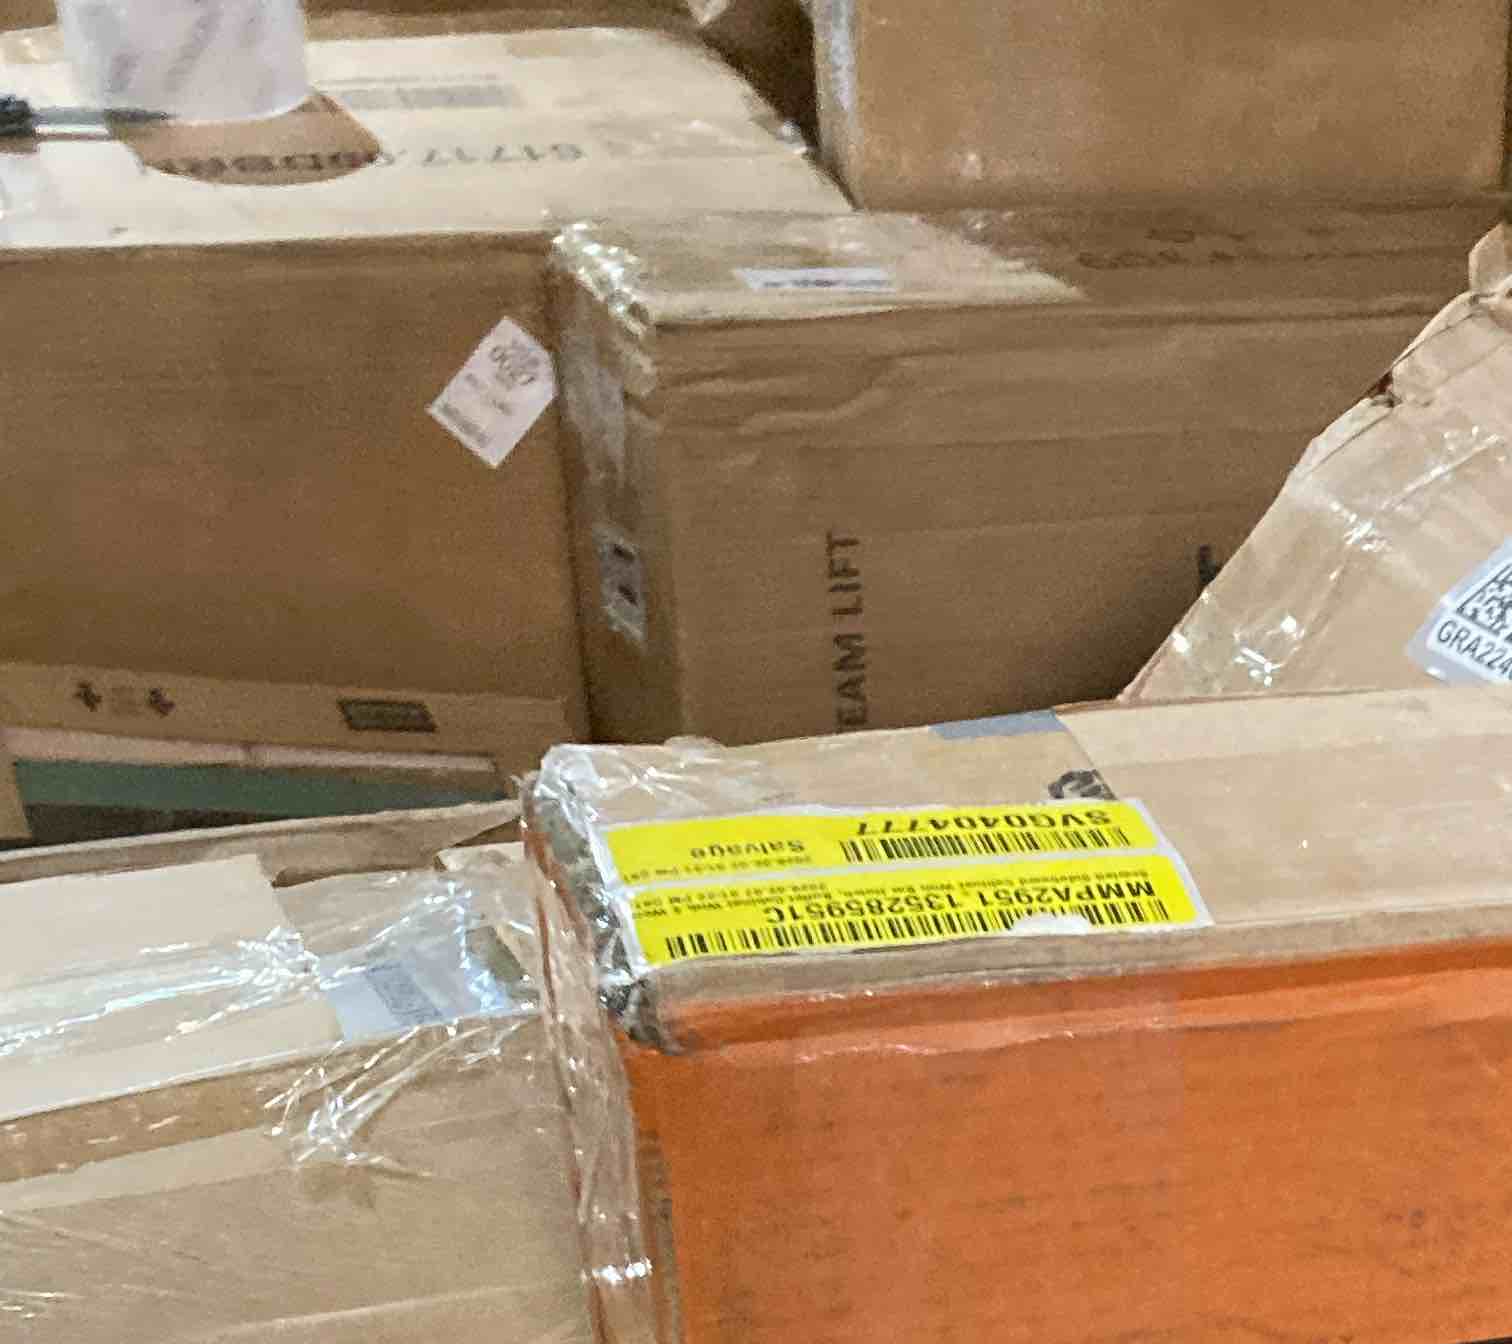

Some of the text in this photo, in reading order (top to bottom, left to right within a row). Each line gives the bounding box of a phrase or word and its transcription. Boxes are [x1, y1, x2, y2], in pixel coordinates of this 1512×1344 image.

[826, 531, 867, 734] EAM LIFT
[690, 839, 806, 859] Salvage
